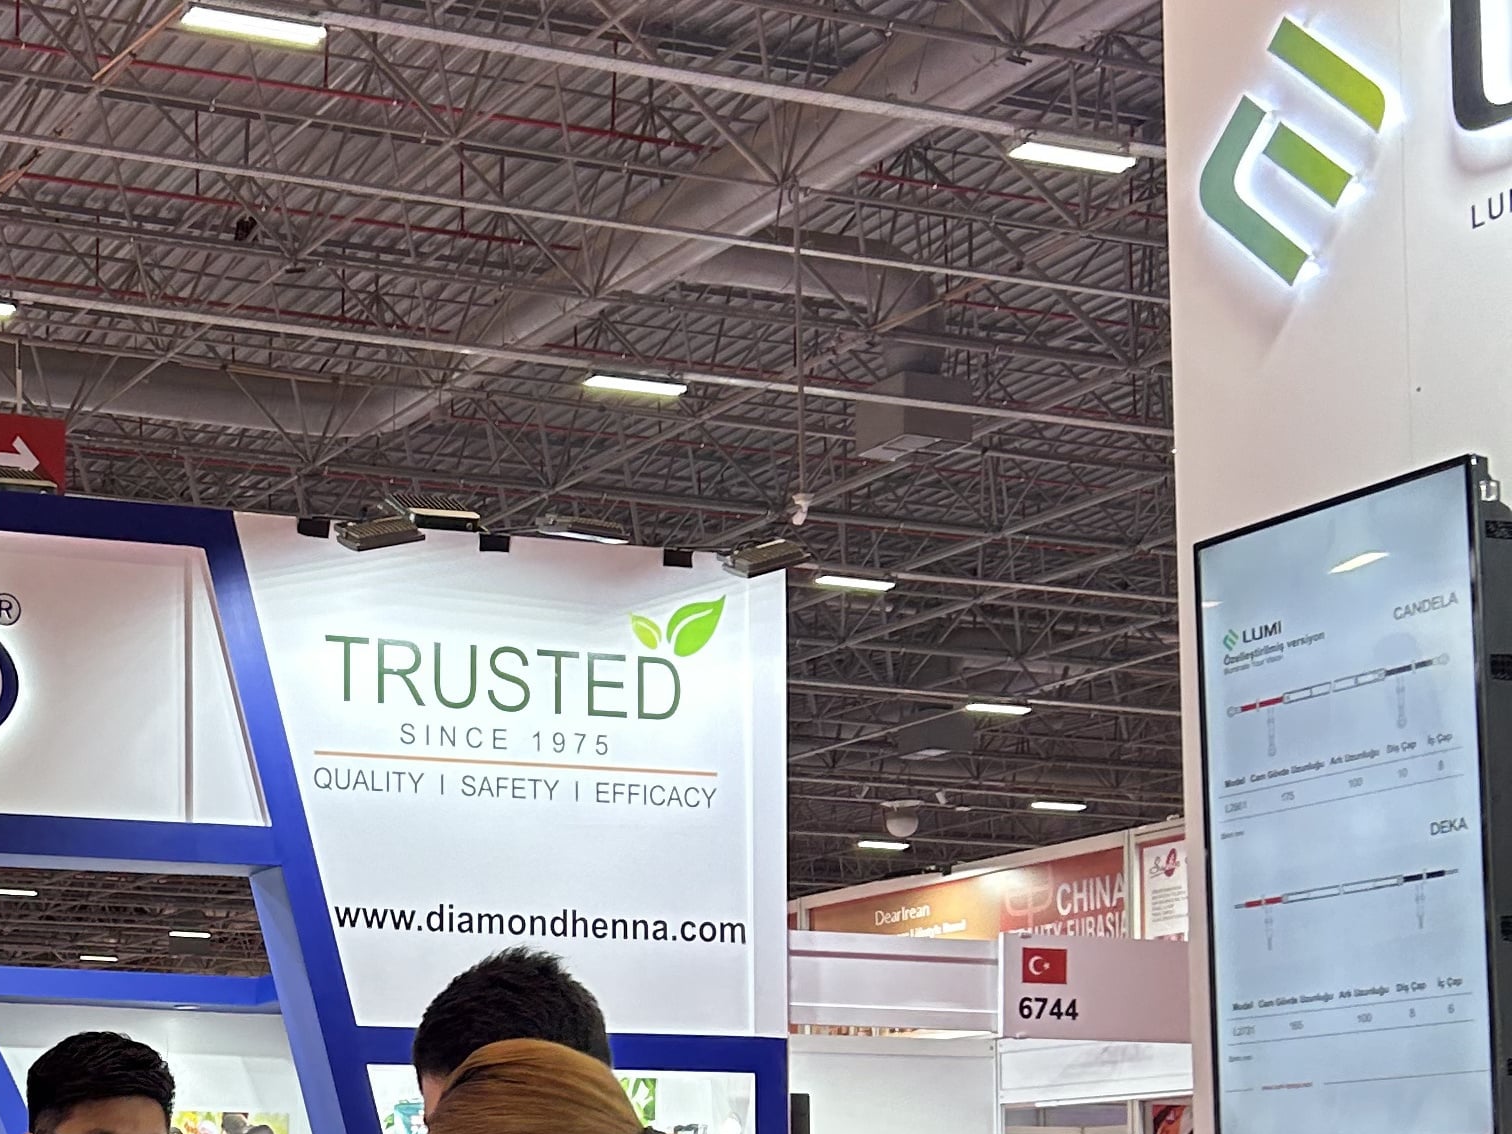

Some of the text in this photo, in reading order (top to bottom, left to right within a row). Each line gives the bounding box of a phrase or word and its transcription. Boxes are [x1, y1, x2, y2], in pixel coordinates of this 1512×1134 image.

[1393, 592, 1459, 621] CANDELA
[1242, 620, 1282, 644] LUMI
[324, 634, 681, 721] TRUSTED
[400, 723, 610, 756] SINCE 1975
[313, 767, 425, 794] QUALITY
[461, 775, 560, 801] SAFETY
[595, 782, 718, 809] EFFICACY
[1430, 817, 1468, 835] DEKA
[1056, 872, 1128, 916] CHINA
[334, 904, 747, 945] www.diamondhenna.com
[1019, 997, 1079, 1020] 6744
